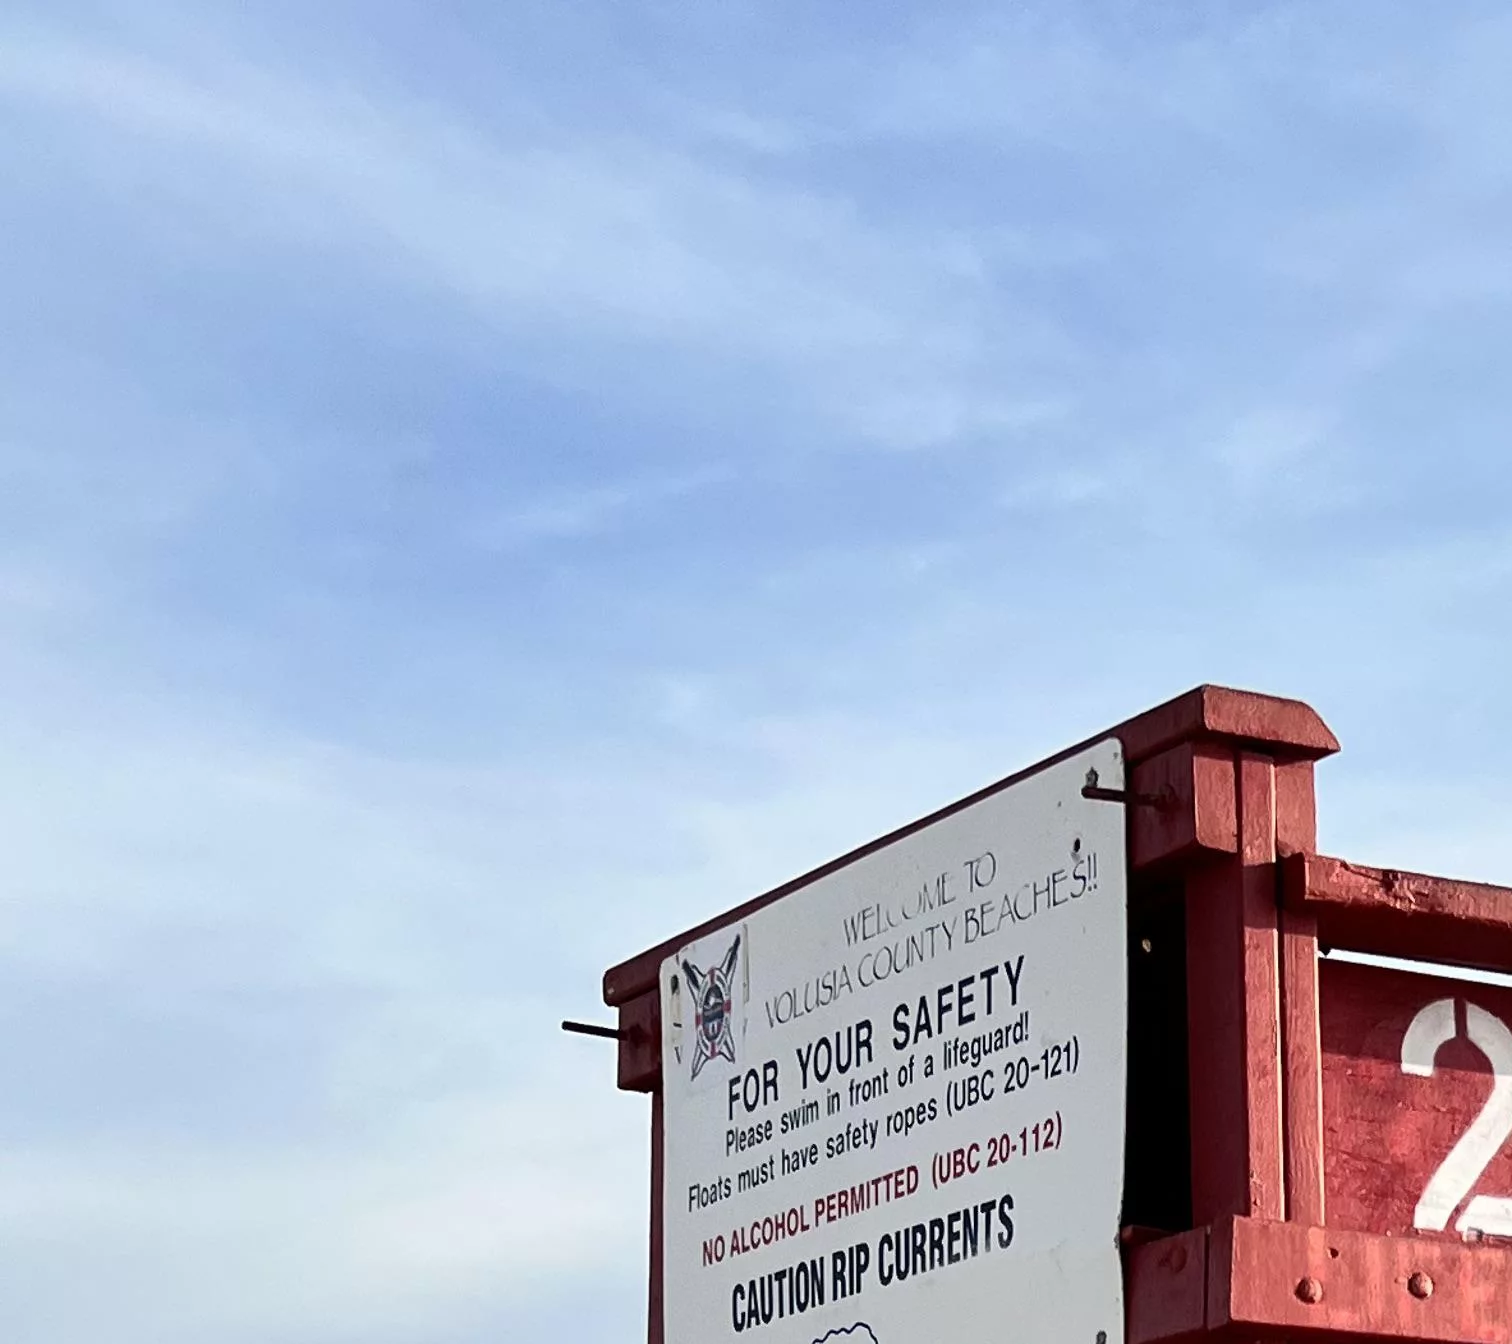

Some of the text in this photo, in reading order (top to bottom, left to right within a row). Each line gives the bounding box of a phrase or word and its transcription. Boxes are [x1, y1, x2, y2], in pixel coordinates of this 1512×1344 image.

[765, 853, 1098, 1028] VOLUSIA COUNTY BEACHES!!
[963, 852, 996, 892] TO
[726, 1011, 1030, 1157] Please swim in front of a lifeguard!
[728, 955, 1025, 1121] FOR YOUR SAFETY
[688, 1034, 1080, 1212] Floats must have safety ropes (UBC 20-121)
[702, 1110, 1063, 1266] NO ALCOHOL PERMITTED (UBC 20-112)
[732, 1194, 1015, 1332] CAUTION RIP CURRENTS
